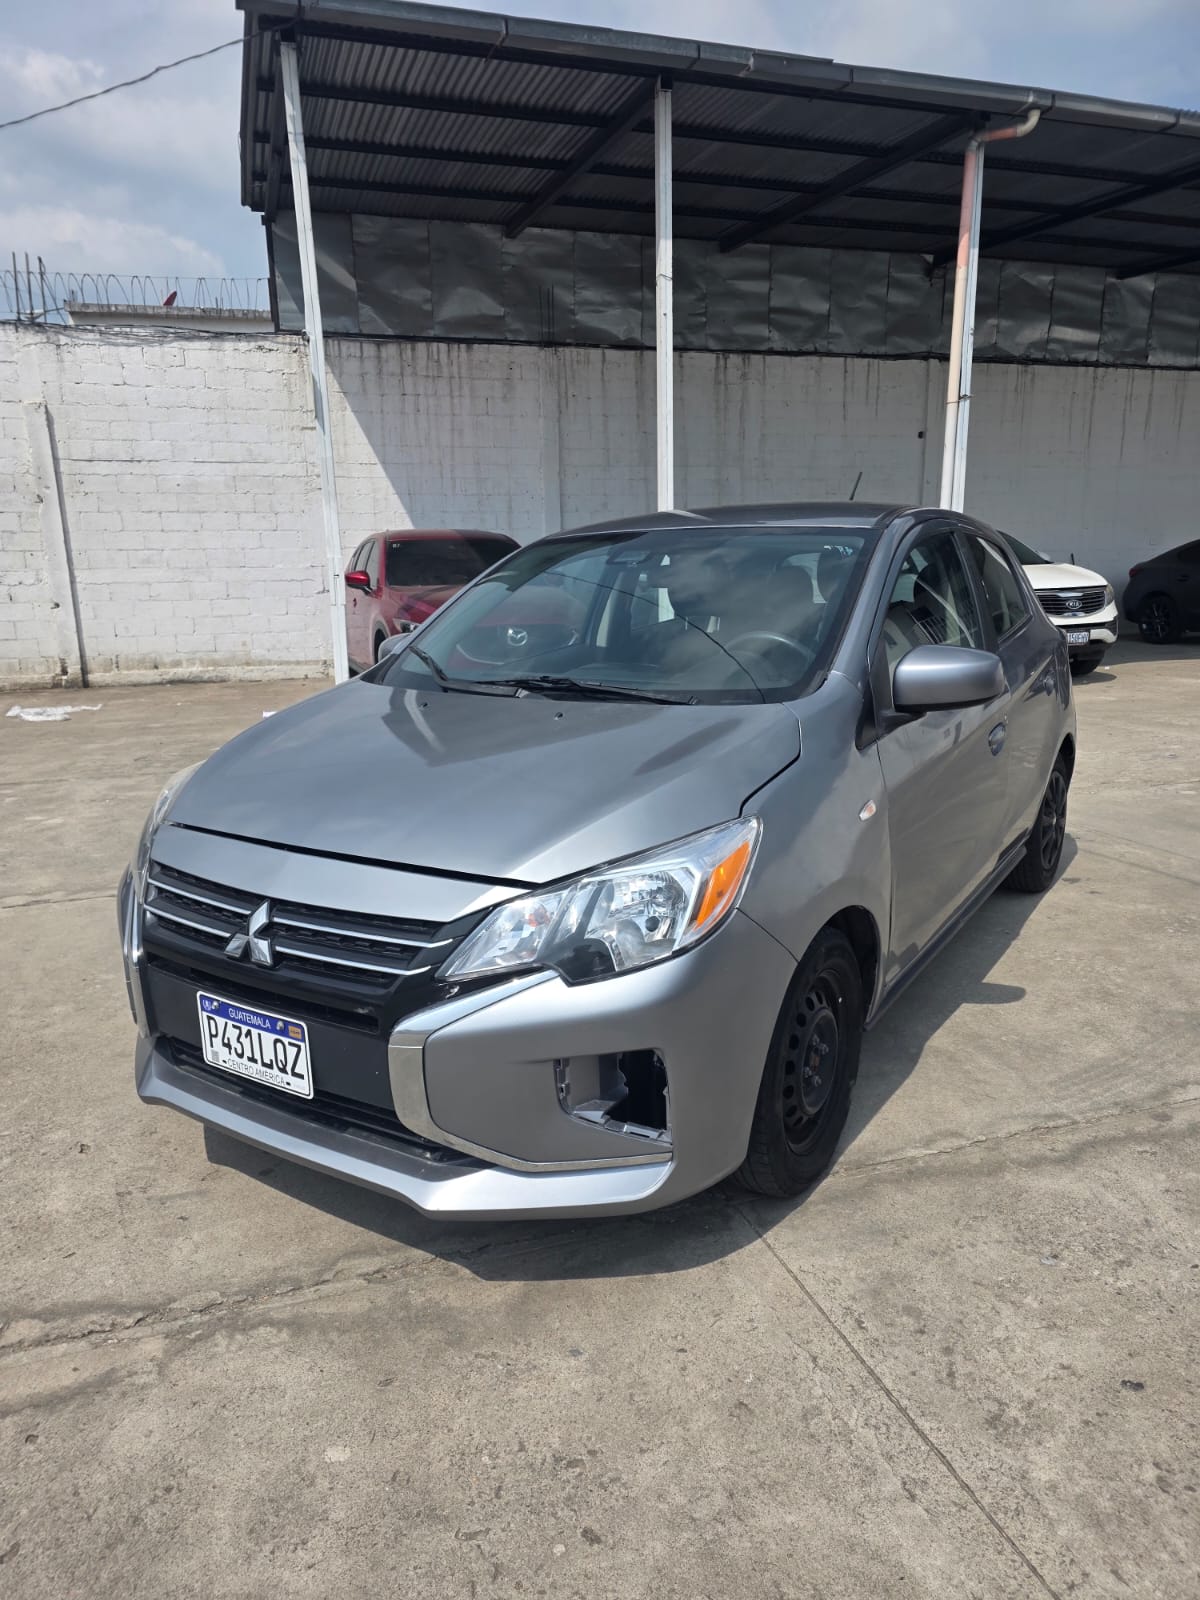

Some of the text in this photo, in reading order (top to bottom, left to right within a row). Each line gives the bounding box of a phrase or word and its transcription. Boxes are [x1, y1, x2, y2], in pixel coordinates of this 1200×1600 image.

[228, 1007, 272, 1030] GUATEMALA
[206, 1014, 305, 1080] P431LQZ
[227, 1058, 286, 1085] CENTRO AMERICA
